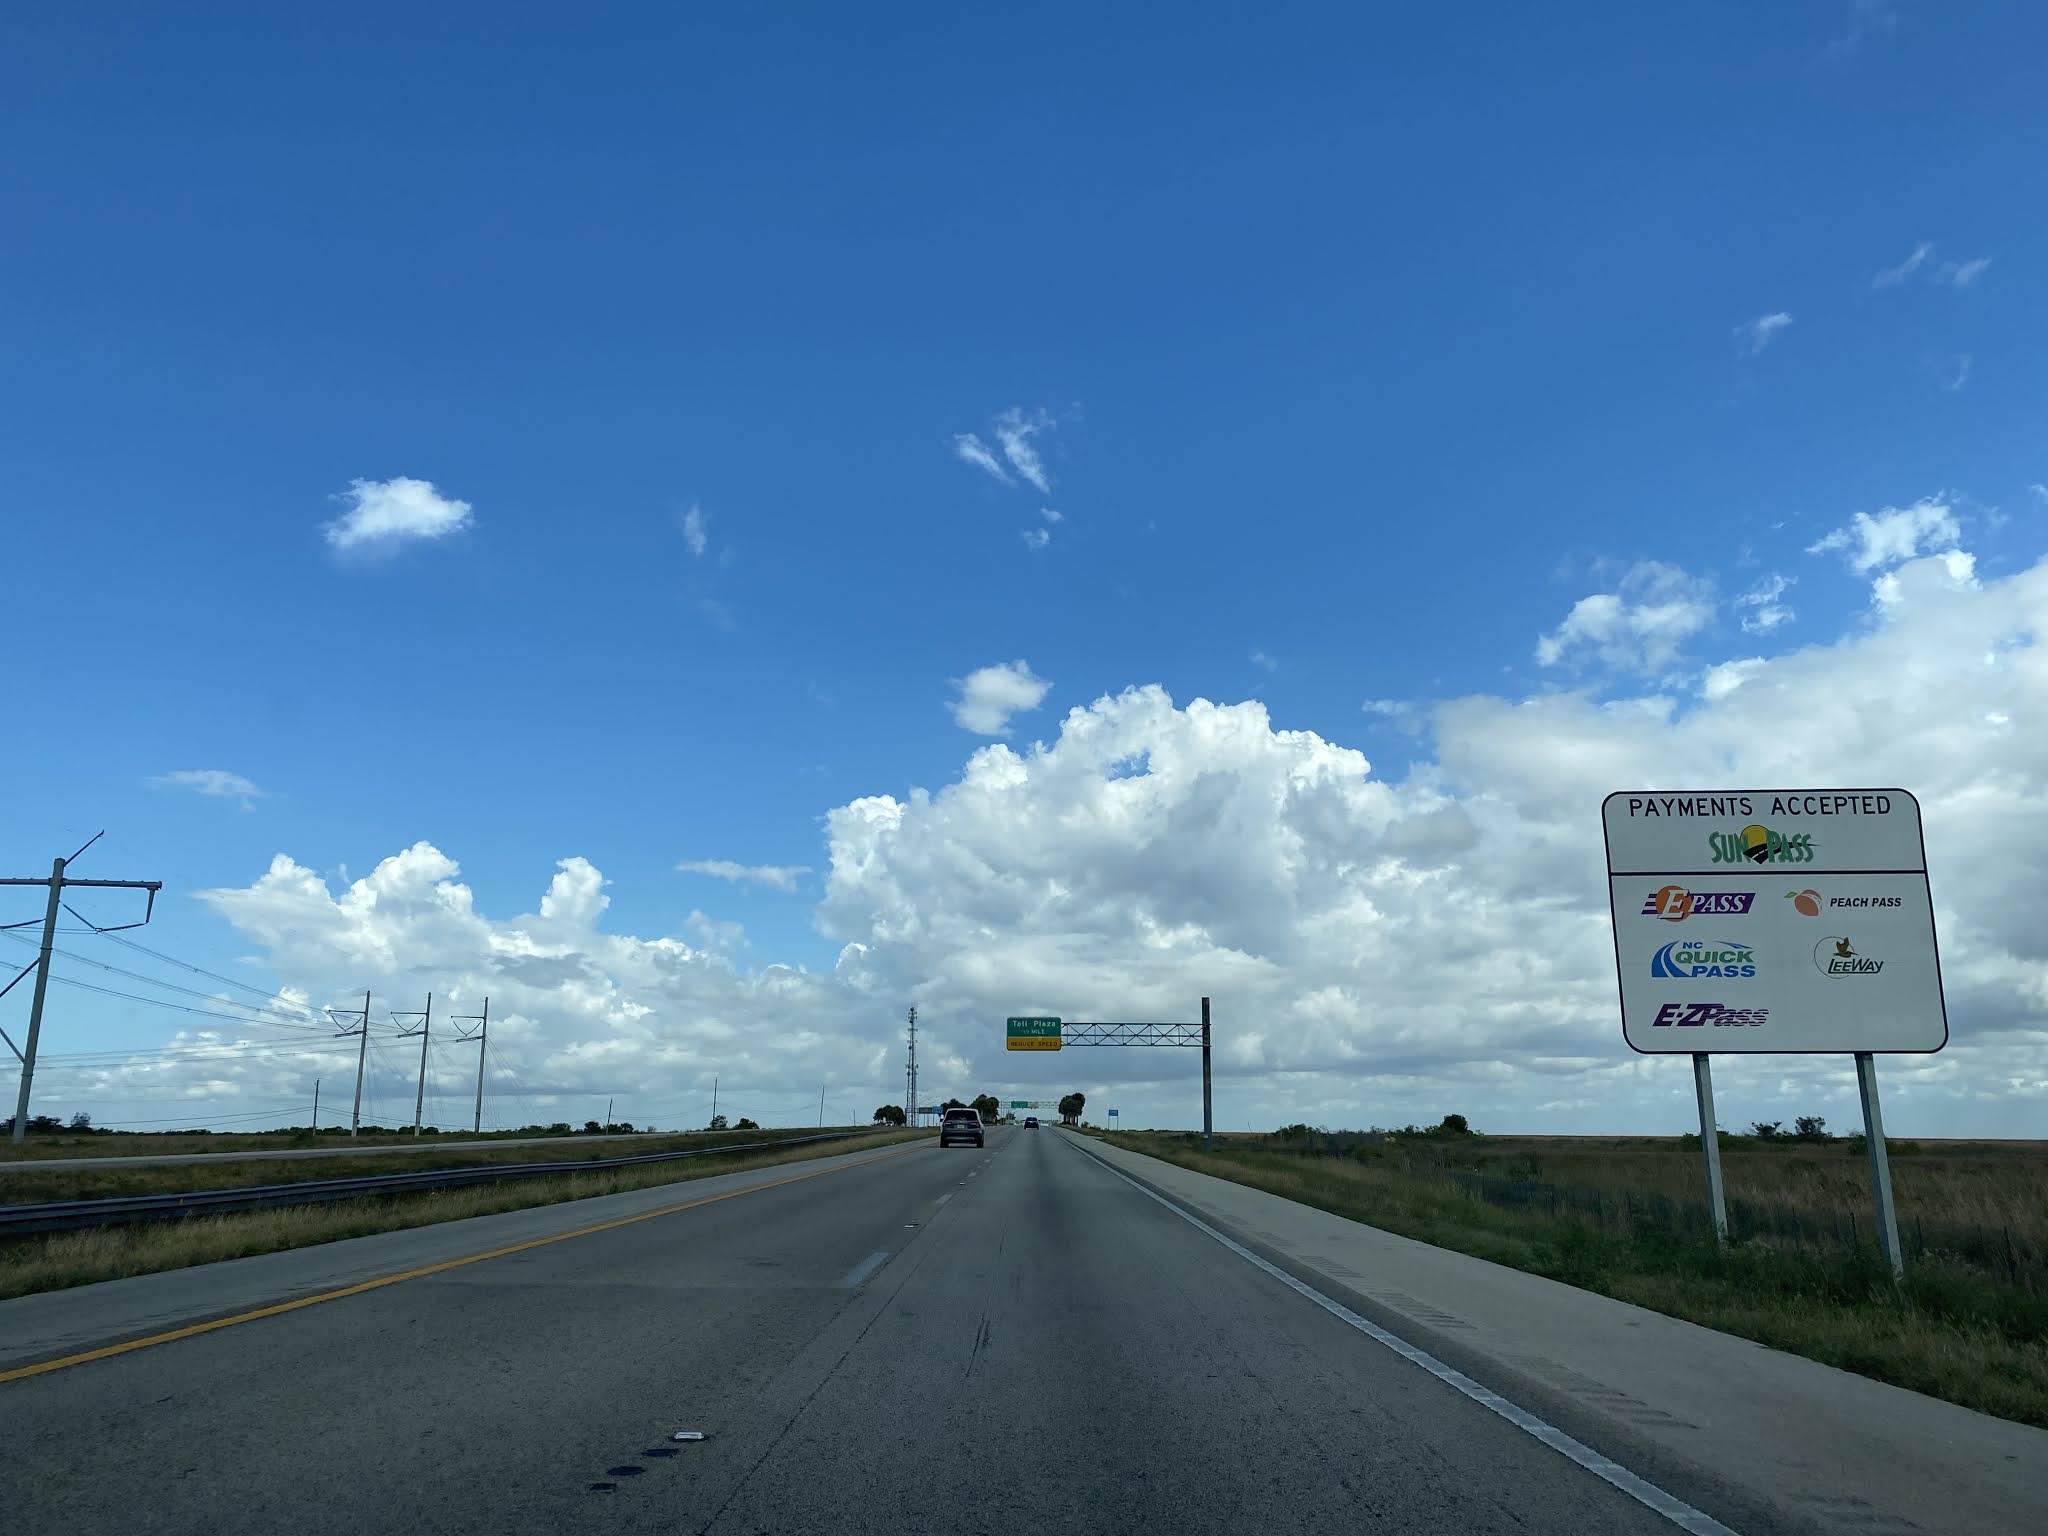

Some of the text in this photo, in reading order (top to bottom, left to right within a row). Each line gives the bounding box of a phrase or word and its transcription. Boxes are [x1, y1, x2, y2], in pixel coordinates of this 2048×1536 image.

[1629, 796, 1891, 817] PAYMENTS ACCEPTED
[1830, 897, 1902, 908] PEACH PASS
[1675, 951, 1755, 964] QUICK
[1692, 965, 1756, 978] PASS
